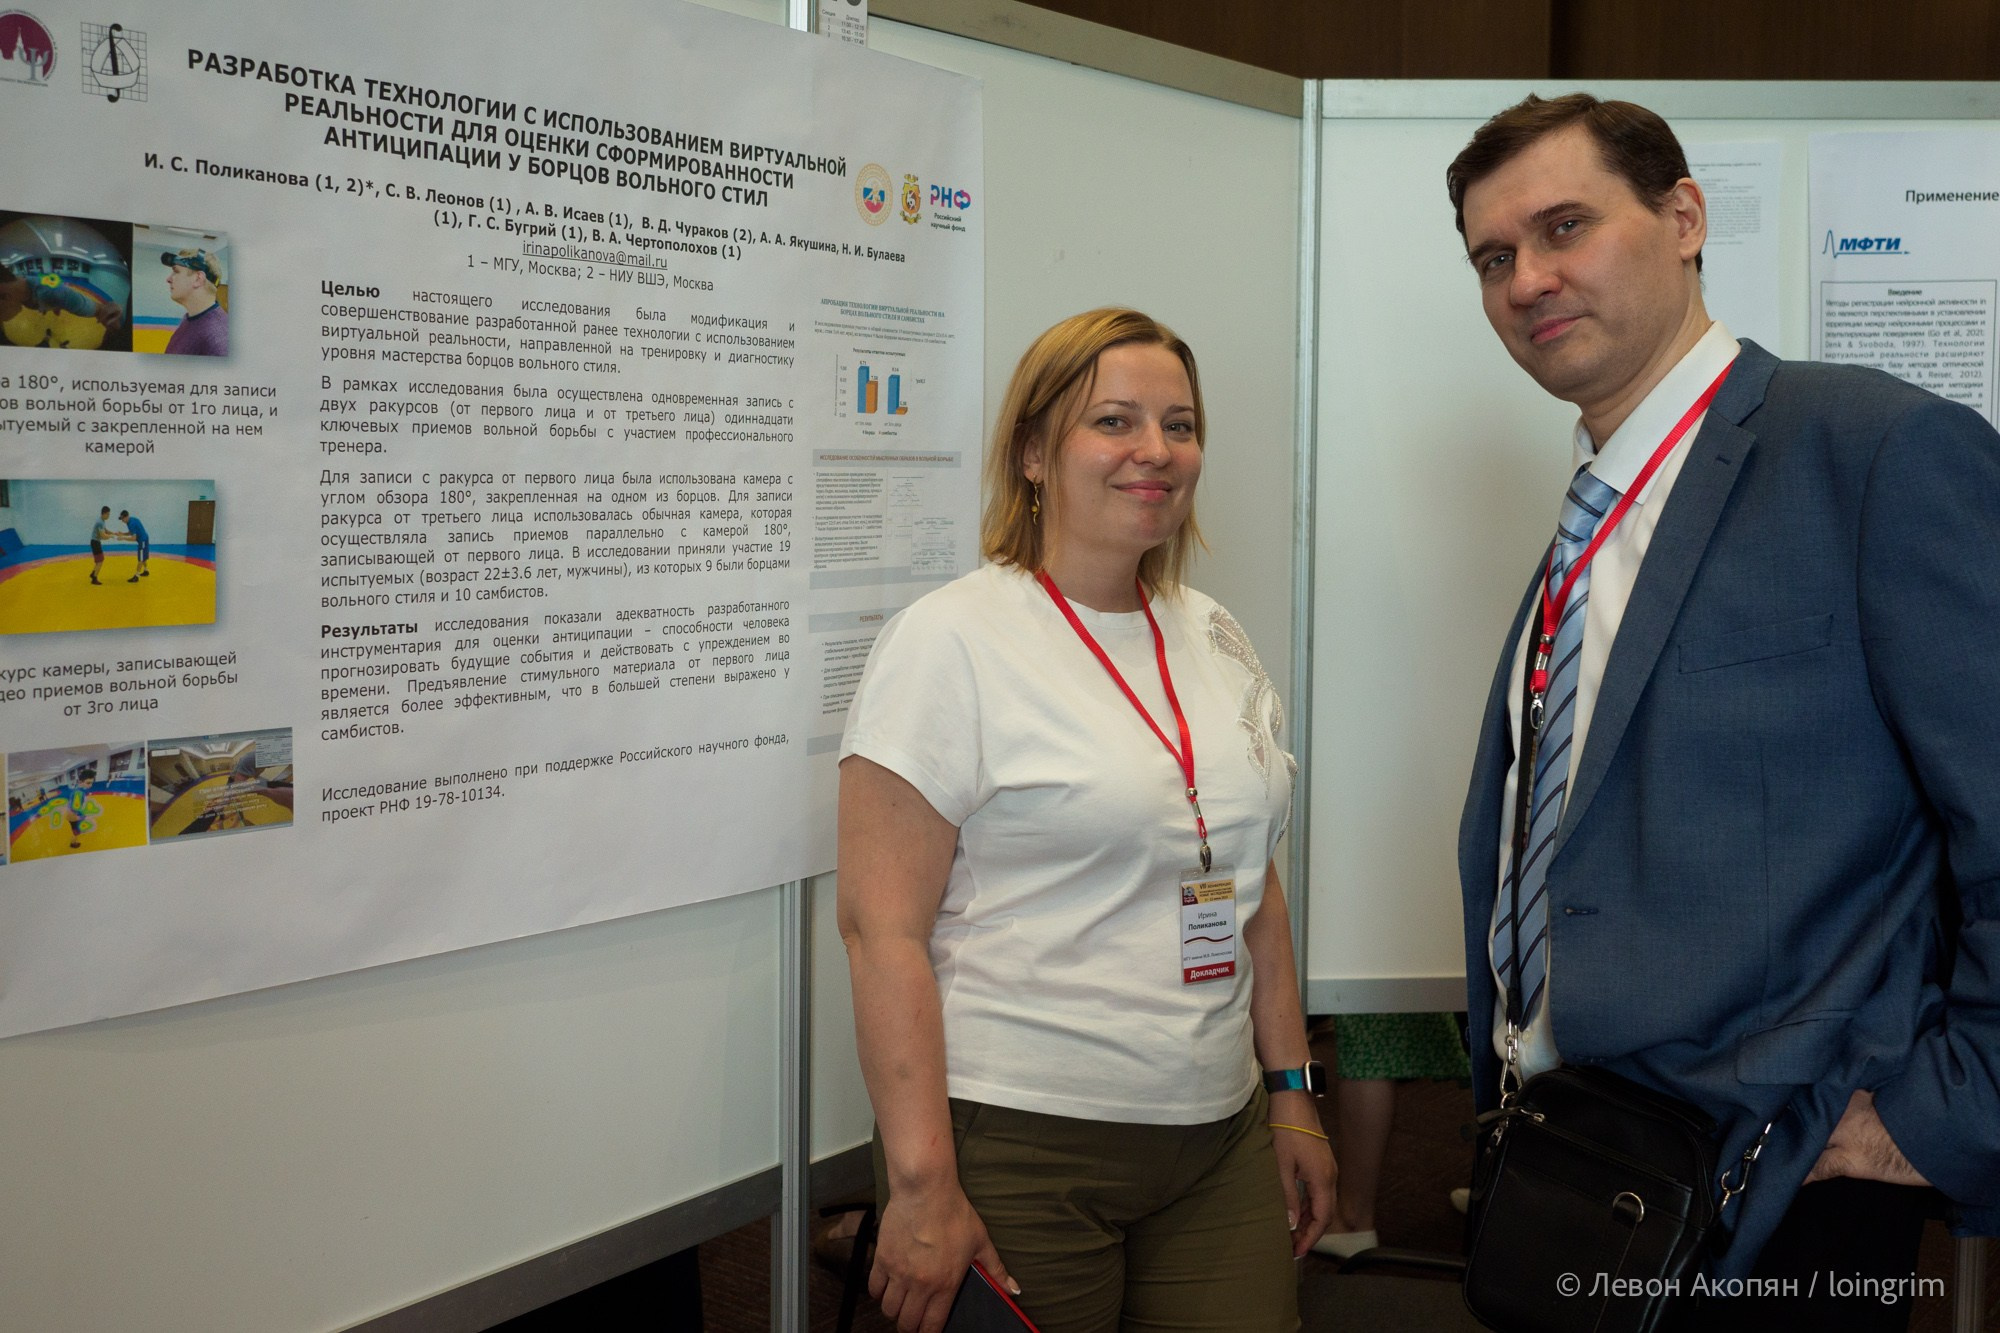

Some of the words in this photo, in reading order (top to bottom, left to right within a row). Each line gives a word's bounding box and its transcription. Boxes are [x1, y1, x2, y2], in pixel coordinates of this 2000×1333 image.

[188, 48, 356, 96] РАЗРАБОТКА
[364, 78, 516, 122] ТЕХНОЛОГИИ
[524, 106, 537, 125] С
[543, 109, 723, 156] ИСПОЛЬЗОВАНИЕМ
[730, 141, 846, 177] ВИРТУАЛЬНОЙ
[285, 92, 443, 136] РЕАЛЬНОСТИ
[451, 119, 497, 144] ДЛЯ
[504, 128, 589, 158] ОЦЕНКИ
[596, 142, 793, 189] СФОРМИРОВАННОСТИ
[324, 126, 501, 170] АНТИЦИПАЦИИ
[508, 153, 522, 171] У
[528, 156, 610, 185] БОРЦОВ
[616, 169, 716, 200] ВОЛЬНОГО
[721, 185, 768, 207] СТИЛ
[144, 152, 164, 170] И.
[170, 156, 188, 173] С.
[195, 159, 309, 187] Поликанова
[315, 174, 340, 194] (1,
[385, 183, 400, 198] С.
[406, 185, 420, 201] В.
[425, 188, 484, 208] Леонов
[489, 196, 511, 215] (1)
[525, 201, 539, 216] А.
[544, 203, 558, 218] В.
[563, 206, 605, 224] Исаев
[608, 212, 633, 230] (1),
[642, 216, 654, 230] В.
[657, 218, 671, 234] Д.
[675, 220, 729, 239] Чураков
[733, 227, 756, 245] (2),
[760, 231, 771, 244] А.
[774, 233, 786, 246] А.
[789, 235, 839, 255] Якушина,
[842, 243, 851, 255] Н.
[854, 245, 864, 257] И.
[867, 247, 906, 263] Булаева
[930, 184, 971, 210] РНФ
[1905, 190, 2000, 205] Применение
[434, 209, 463, 229] (1),
[468, 213, 481, 228] Г.
[486, 216, 500, 230] С.
[505, 218, 556, 238] Бугрий
[561, 225, 588, 243] (1),
[592, 228, 605, 243] В.
[608, 231, 621, 245] А.
[625, 233, 718, 256] Чертополохов
[722, 244, 741, 261] (1)
[931, 222, 950, 231] научный
[951, 224, 966, 232] фонд
[522, 241, 668, 270] irinapolikanova@mail.ru
[1838, 237, 1901, 251] МФТИ
[468, 254, 475, 268] 1
[494, 256, 523, 275] МГУ,
[528, 260, 581, 281] Москва;
[586, 266, 594, 279] 2
[609, 268, 634, 283] НИУ
[637, 271, 669, 289] ВШЭ,
[673, 275, 714, 291] Москва
[321, 280, 380, 298] Целью
[413, 291, 493, 308] настоящего
[522, 300, 610, 317] исследования
[636, 306, 666, 322] была
[691, 314, 768, 330] модификация
[789, 323, 795, 332] и
[321, 304, 469, 326] совершенствование
[476, 316, 576, 333] разработанной
[583, 324, 618, 337] ранее
[623, 327, 690, 341] технологии
[695, 332, 701, 342] с
[706, 333, 795, 349] использованием
[321, 325, 419, 342] виртуальной
[429, 332, 510, 351] реальности,
[520, 339, 612, 354] направленной
[620, 345, 634, 356] на
[641, 347, 707, 363] тренировку
[714, 352, 721, 361] и
[728, 353, 795, 368] диагностику
[321, 346, 375, 362] уровня
[382, 350, 462, 366] мастерства
[466, 352, 514, 369] борцов
[519, 358, 579, 371] вольного
[583, 361, 621, 373] стиля.
[1880, 351, 1929, 359] реальности
[1935, 351, 1984, 359] расширяют
[72, 380, 185, 396] используемая
[189, 384, 218, 397] для
[224, 385, 276, 397] записи
[26, 397, 96, 412] вольной
[102, 398, 163, 416] борьбы
[168, 403, 185, 414] от
[191, 401, 217, 415] 1го
[221, 405, 263, 419] лица,
[269, 406, 278, 416] и
[77, 421, 86, 432] с
[91, 420, 205, 436] закрепленной
[212, 424, 230, 435] на
[236, 425, 263, 436] нем
[85, 439, 154, 456] камерой
[43, 663, 110, 678] камеры,
[116, 651, 236, 672] записывающей
[33, 683, 103, 701] приемов
[110, 674, 176, 693] вольной
[182, 670, 238, 689] борьбы
[64, 705, 82, 716] от
[87, 700, 114, 714] 3го
[119, 698, 158, 712] лица
[322, 779, 427, 802] Исследование
[434, 768, 508, 788] выполнено
[515, 764, 538, 779] при
[545, 755, 614, 773] поддержке
[620, 745, 693, 763] Российского
[698, 738, 749, 754] научного
[754, 733, 789, 749] фонда,
[322, 805, 375, 824] проект
[380, 798, 410, 814] РНФ
[416, 785, 505, 809] 19-78-10134.
[1188, 920, 1227, 931] Поликанова
[1197, 911, 1218, 921] Ирина
[1190, 965, 1230, 980] Докладчик
